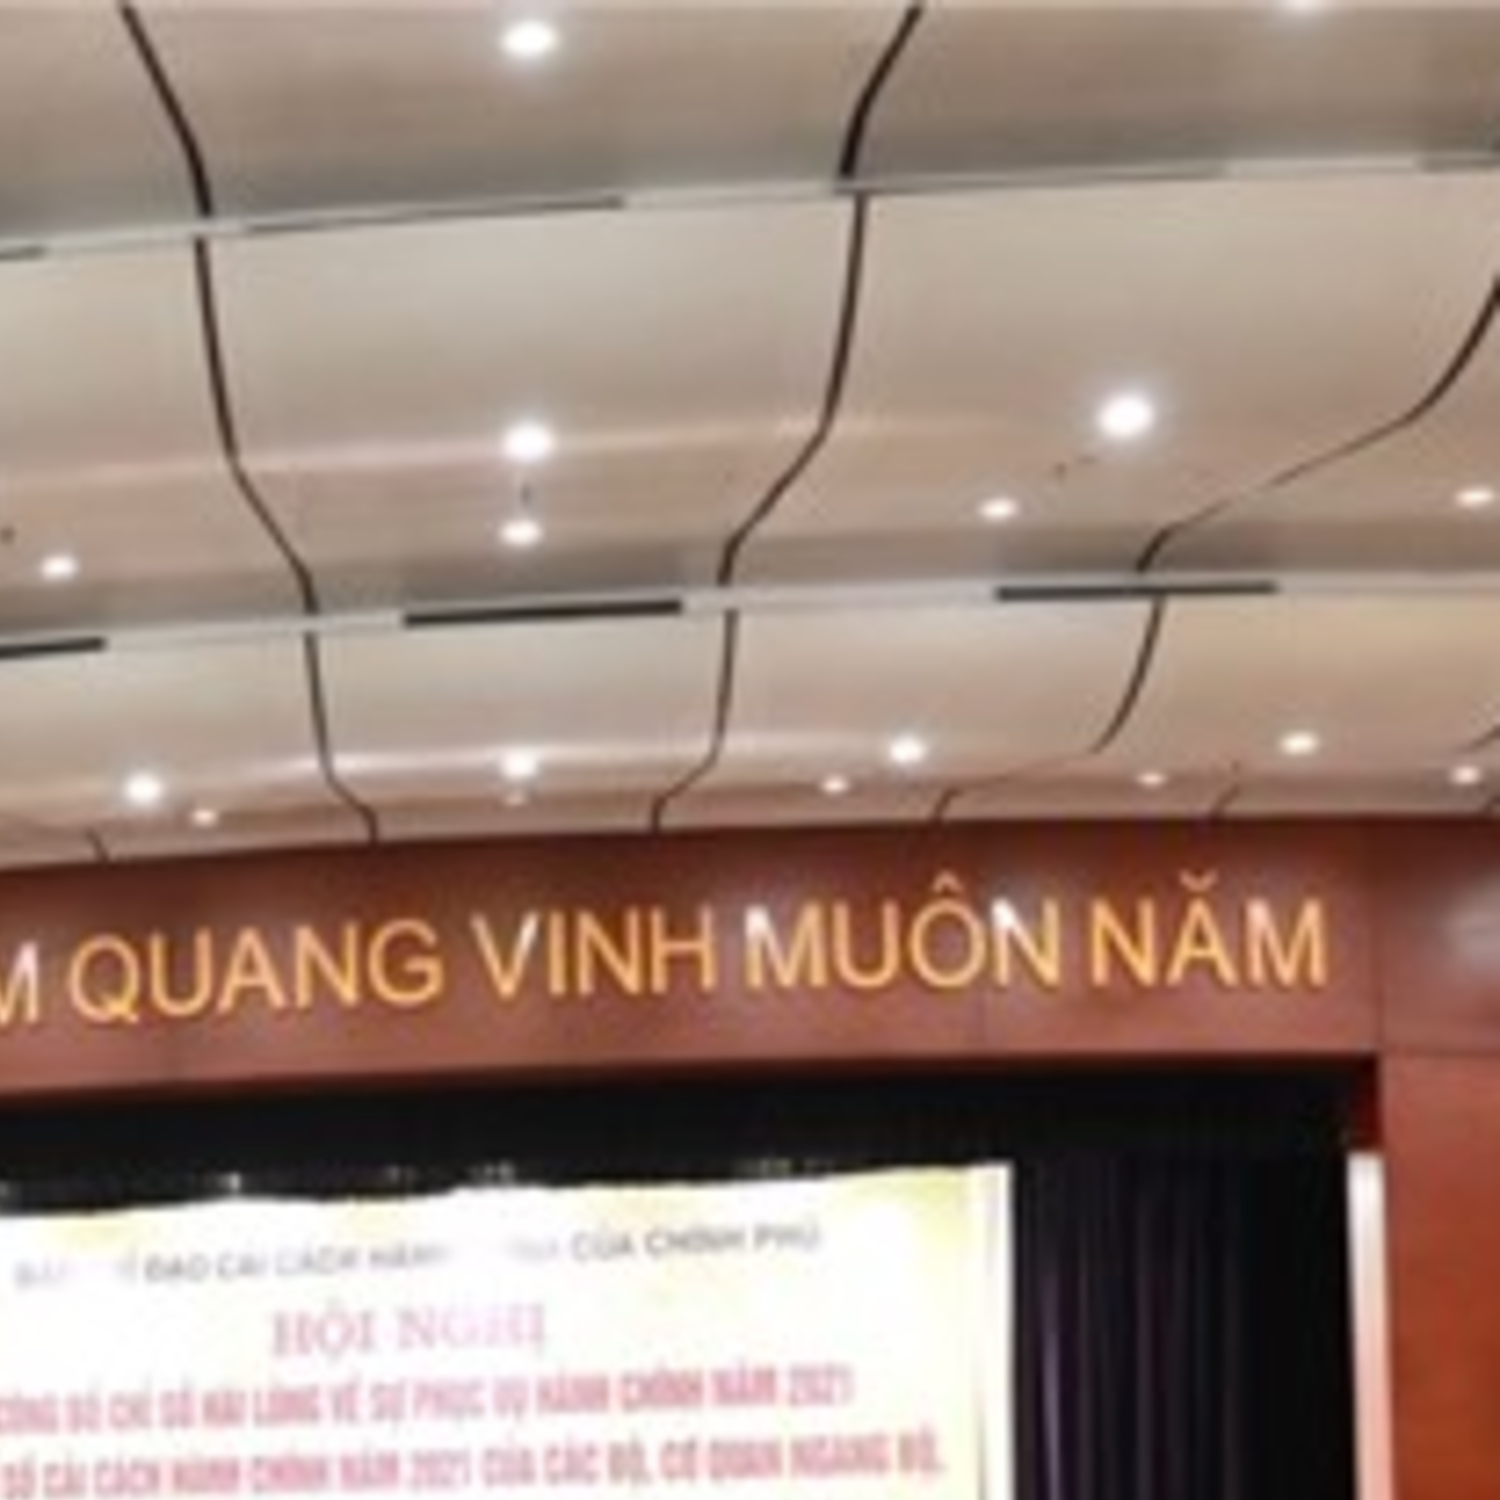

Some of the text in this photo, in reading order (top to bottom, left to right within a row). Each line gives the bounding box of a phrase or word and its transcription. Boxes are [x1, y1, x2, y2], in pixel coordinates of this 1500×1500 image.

[68, 916, 445, 1025] QUANG
[470, 902, 717, 998] VINH
[743, 869, 1062, 992] MUÔN
[1090, 873, 1330, 988] NĂM
[272, 1297, 546, 1365] HỘI NGHỊ
